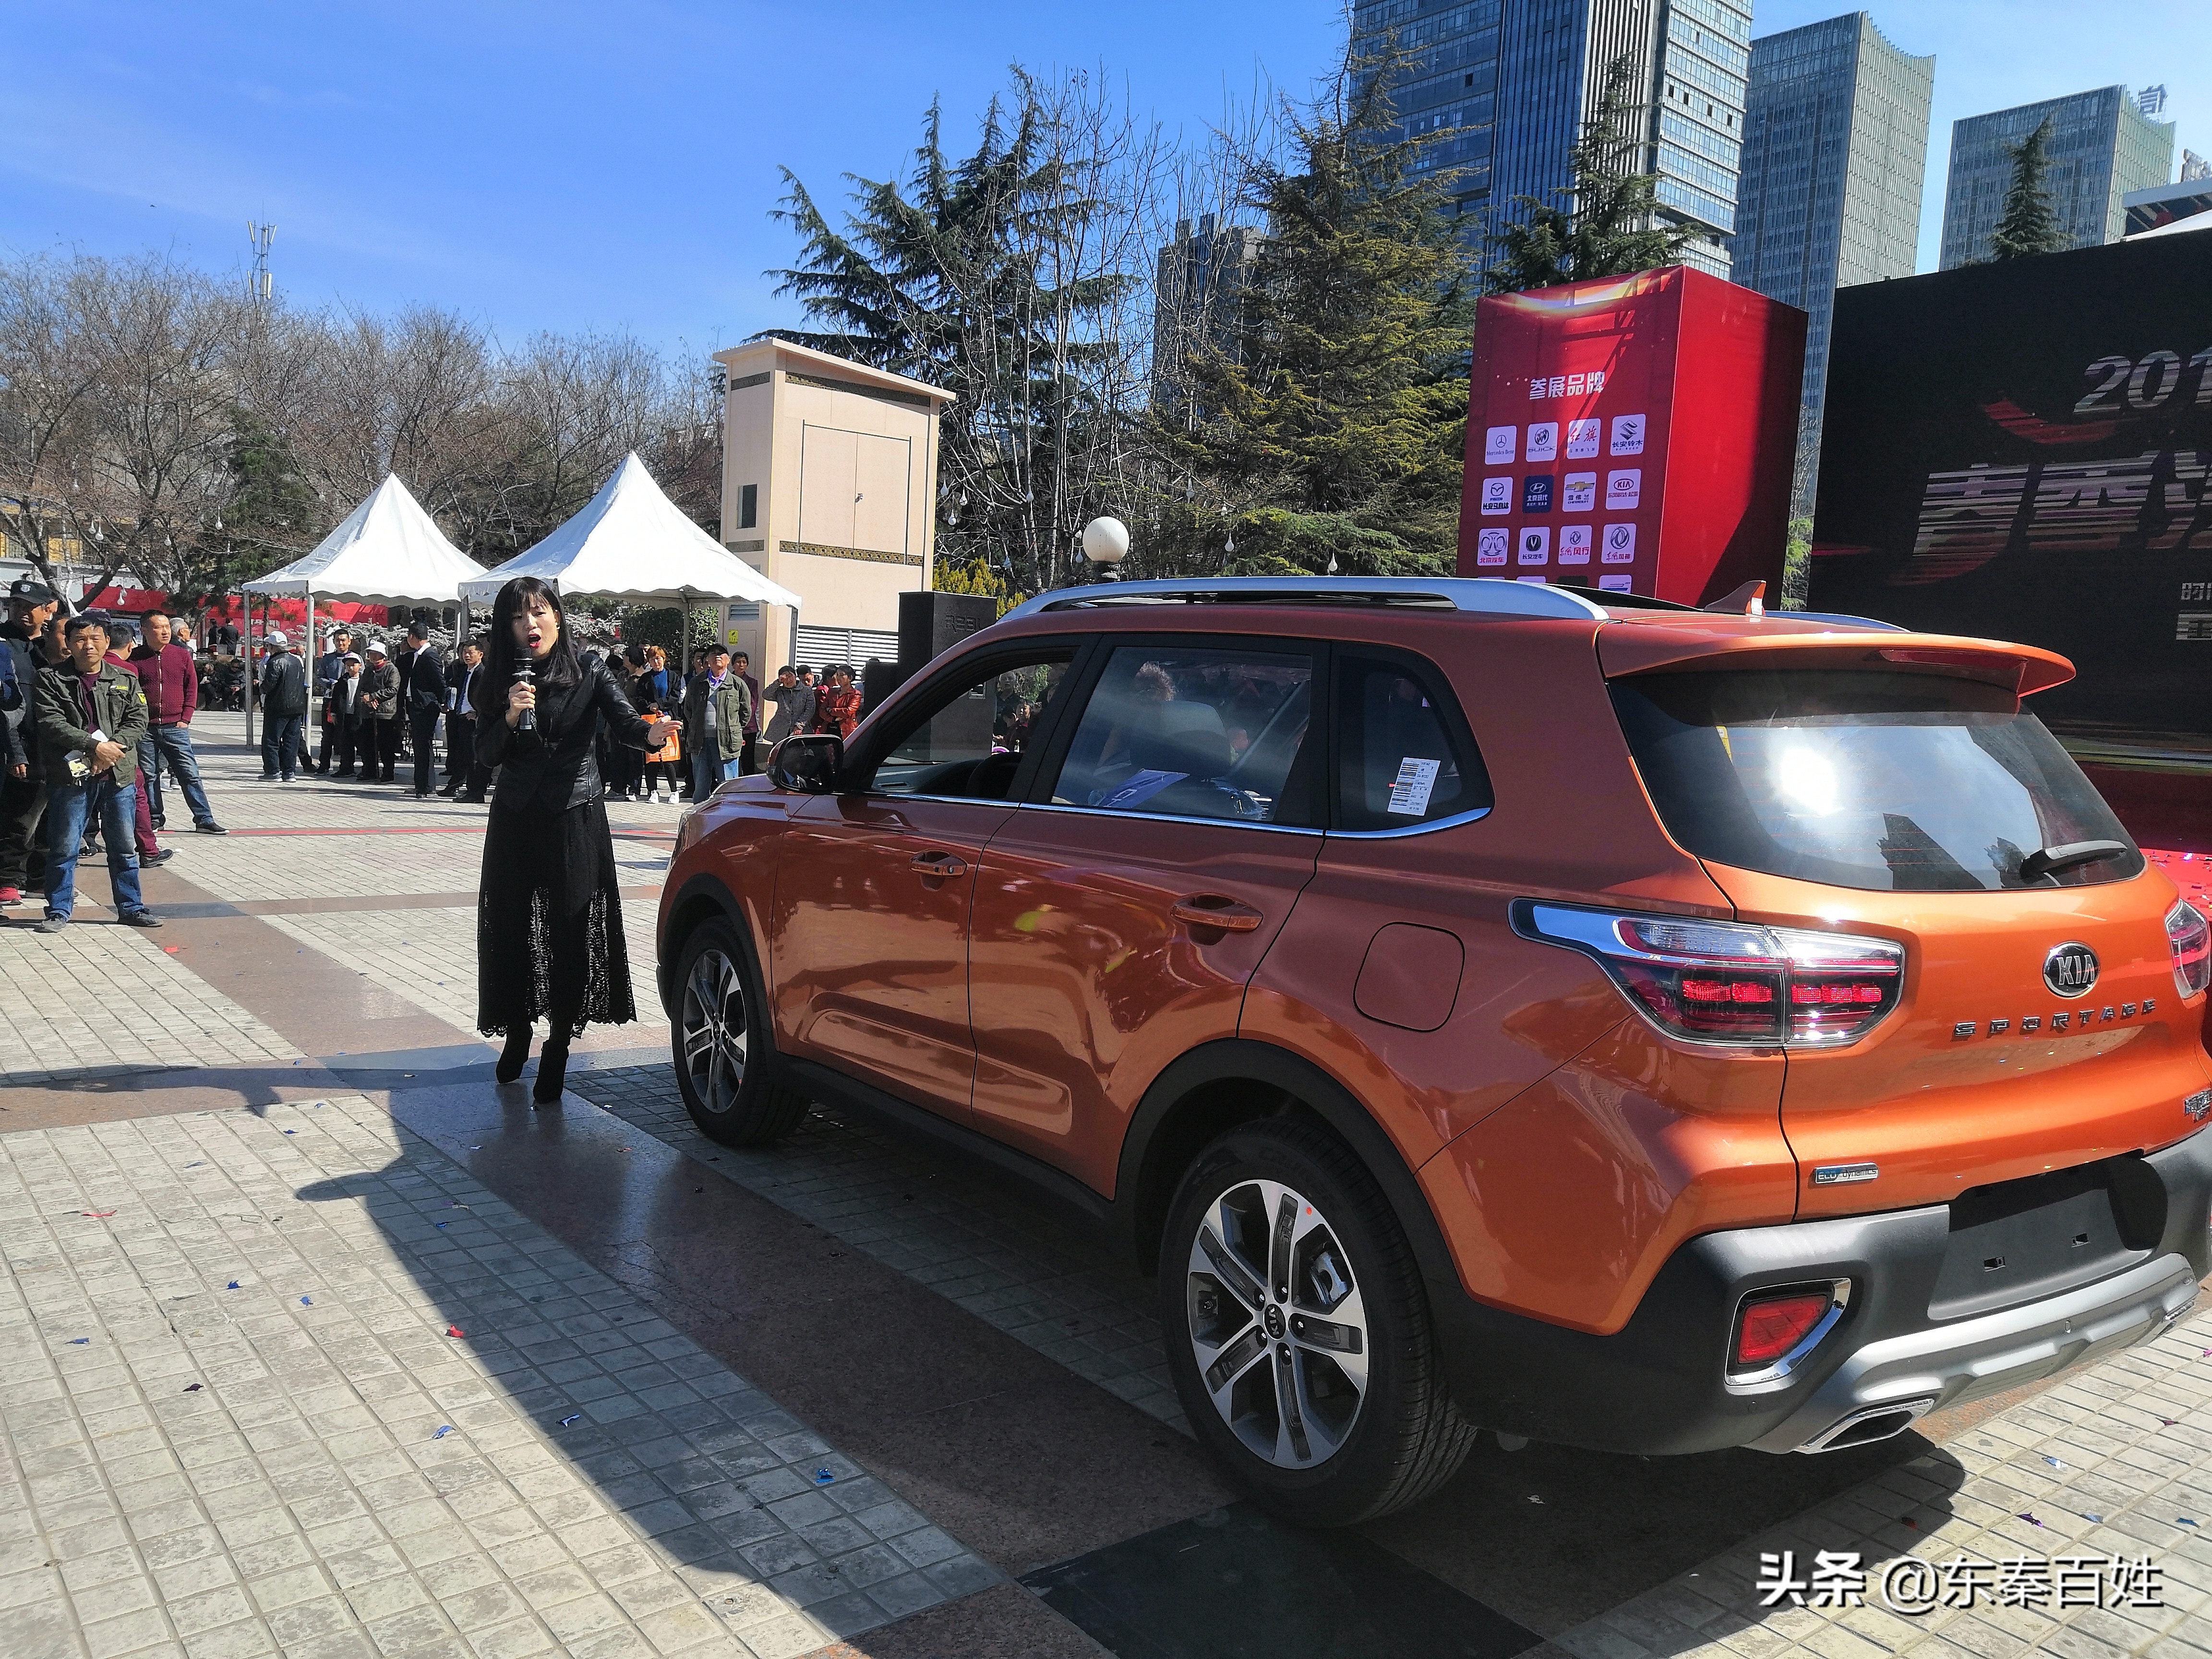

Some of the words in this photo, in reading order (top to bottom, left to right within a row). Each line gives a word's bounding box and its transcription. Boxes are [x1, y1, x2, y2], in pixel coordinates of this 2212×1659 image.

[1529, 371, 1605, 400] 参展品牌
[1570, 425, 1597, 444] 红旗
[2056, 954, 2095, 986] KIA
[1954, 998, 2156, 1037] SPORTAGE
[1842, 1168, 1876, 1179] dynamics
